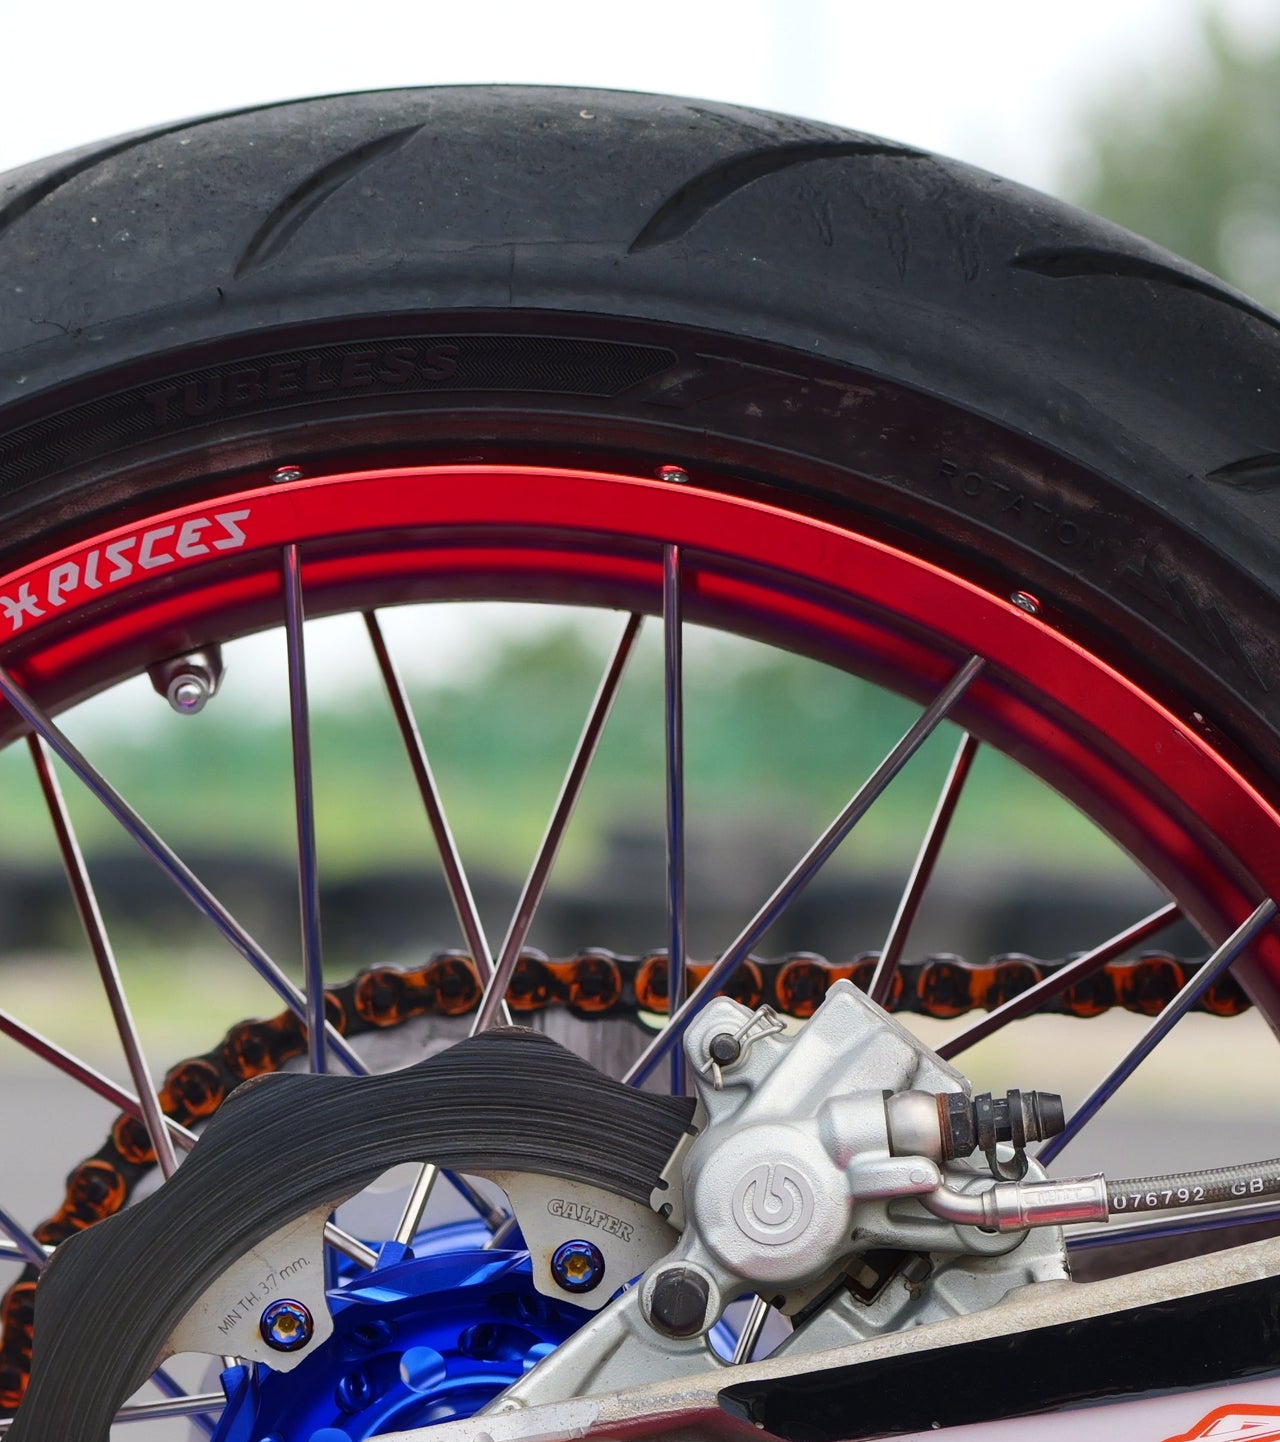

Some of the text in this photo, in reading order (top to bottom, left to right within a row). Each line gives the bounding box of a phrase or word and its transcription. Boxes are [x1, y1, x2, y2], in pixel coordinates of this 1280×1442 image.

[145, 343, 460, 427] TUBELESS
[47, 509, 251, 607] PISCES
[1113, 1186, 1205, 1210] 076792
[1231, 1177, 1264, 1196] GB
[547, 1199, 634, 1243] GALFER
[217, 1309, 242, 1336] MIN
